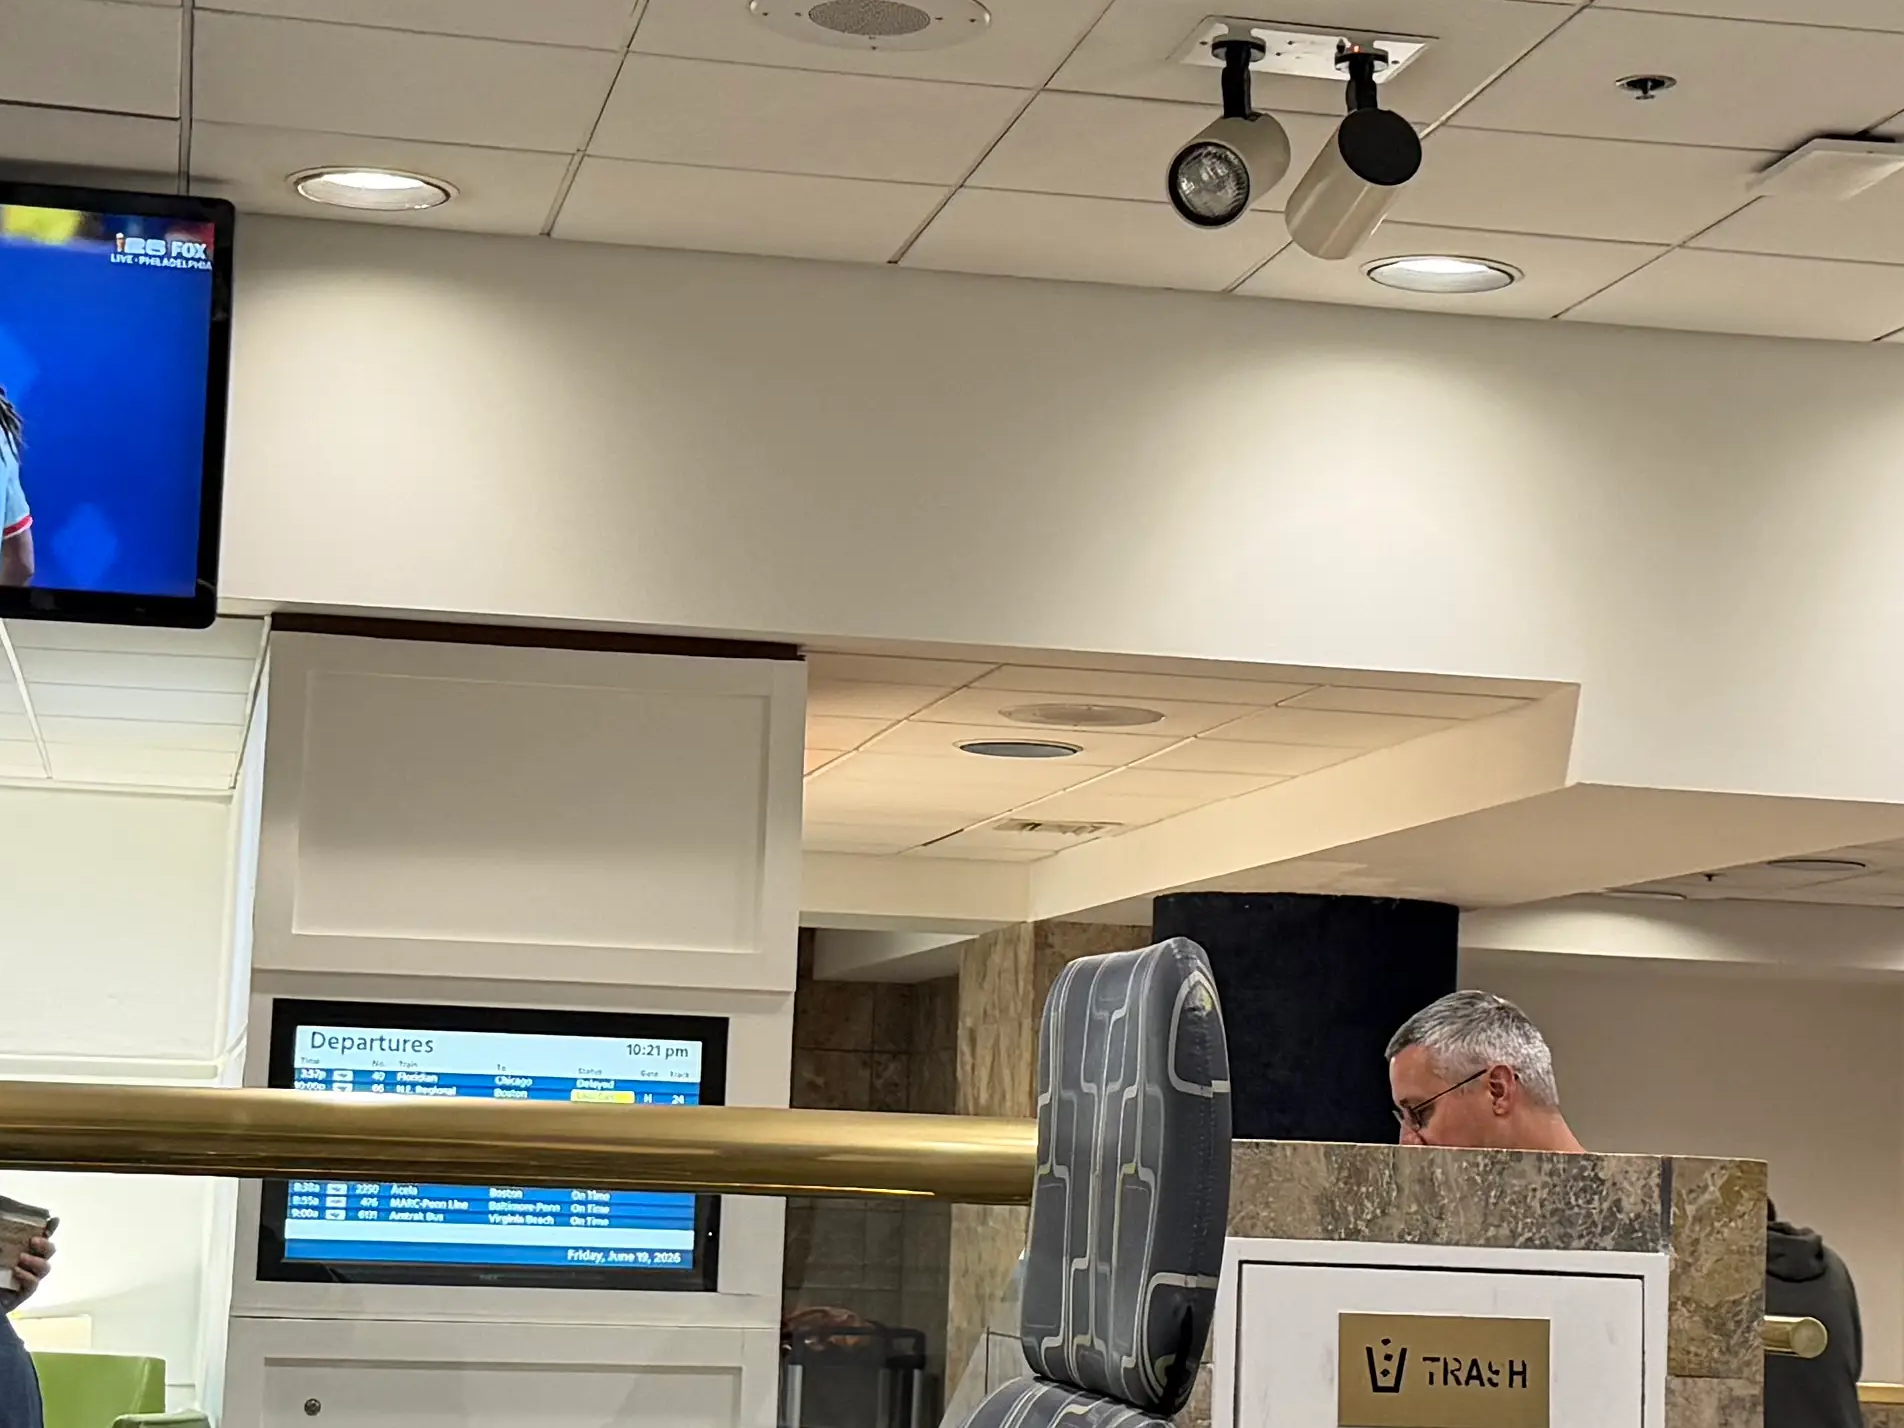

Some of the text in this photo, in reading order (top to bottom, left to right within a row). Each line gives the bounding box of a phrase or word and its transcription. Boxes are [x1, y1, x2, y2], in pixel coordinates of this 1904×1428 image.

[170, 241, 207, 260] FOX
[110, 253, 213, 270] LIVE PHILADELPHIA
[310, 1031, 689, 1060] Departures 10:21 pm
[415, 1084, 457, 1096] Regional
[493, 1088, 528, 1099] Boston
[494, 1075, 533, 1088] Chicago
[576, 1078, 615, 1091] Delayed
[390, 1183, 418, 1196] Acela
[489, 1187, 523, 1199] Boston
[571, 1189, 586, 1201] On
[587, 1189, 611, 1202] Time
[448, 1199, 469, 1210] Line
[570, 1203, 586, 1214] On
[587, 1203, 610, 1214] Time
[389, 1210, 424, 1221] Amtrak
[425, 1211, 444, 1222] Bus
[488, 1213, 525, 1225] Virginia
[525, 1214, 555, 1225] Beach
[570, 1216, 586, 1226] On
[586, 1216, 610, 1227] Time
[567, 1249, 606, 1264] Friday,
[607, 1250, 636, 1263] June
[1422, 1356, 1528, 1389] TRASH
